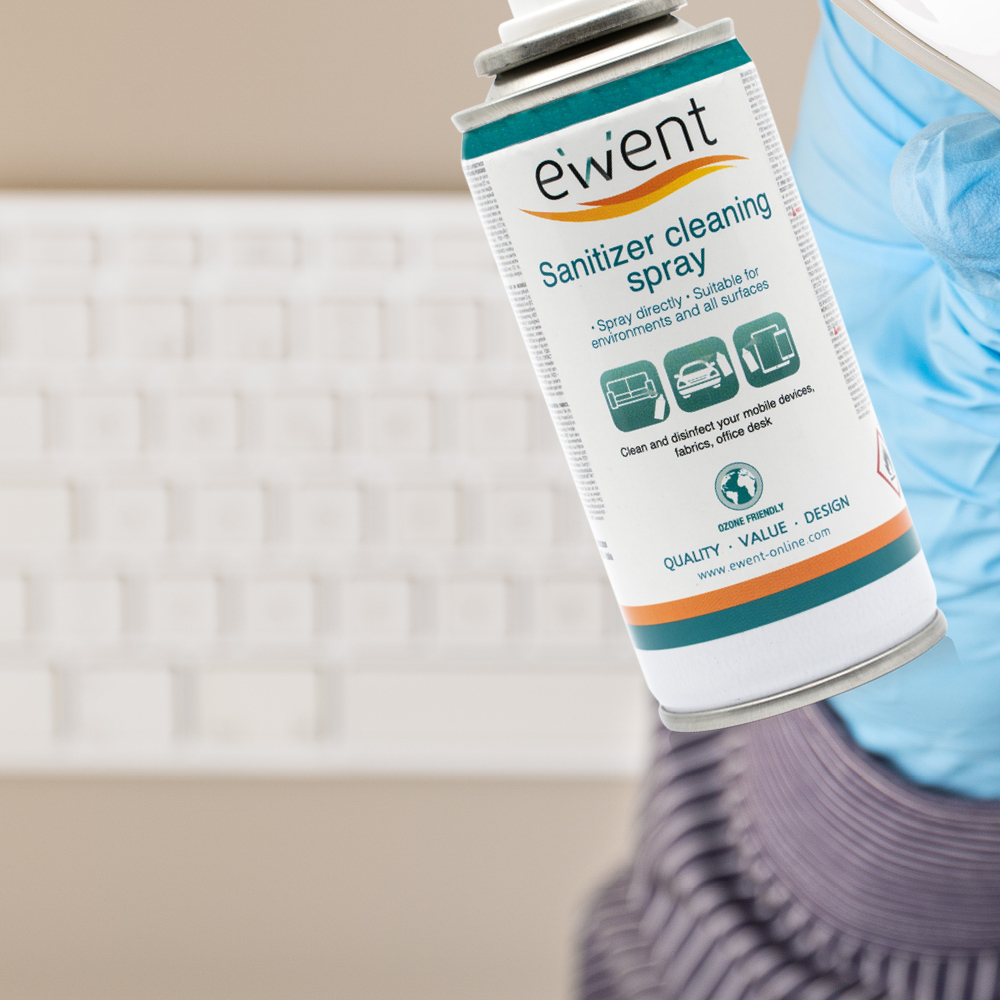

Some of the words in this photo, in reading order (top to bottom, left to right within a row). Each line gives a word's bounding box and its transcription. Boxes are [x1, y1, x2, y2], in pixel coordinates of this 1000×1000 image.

[538, 233, 655, 288] Sanitizer
[665, 192, 772, 247] cleaning
[627, 247, 706, 294] spray
[636, 296, 682, 320] directly
[693, 274, 742, 300] Suitable
[743, 267, 760, 282] for
[591, 316, 672, 350] environments
[675, 305, 701, 322] and
[703, 299, 718, 313] all
[720, 280, 770, 306] surfaces
[619, 443, 649, 458] Clean
[649, 434, 669, 450] and
[671, 420, 716, 444] disinfect
[716, 411, 741, 430] your
[743, 398, 777, 419] mobile
[778, 385, 815, 405] devices,
[674, 439, 714, 458] fabrics,
[715, 428, 745, 444] office
[747, 416, 773, 433] desk
[663, 543, 721, 572] QUALITY
[737, 521, 788, 547] VALUE
[803, 494, 851, 523] DESIGN
[717, 516, 746, 533] OZONE
[746, 502, 785, 523] FRIENDLY
[697, 526, 831, 581] www.ewent-online.com
